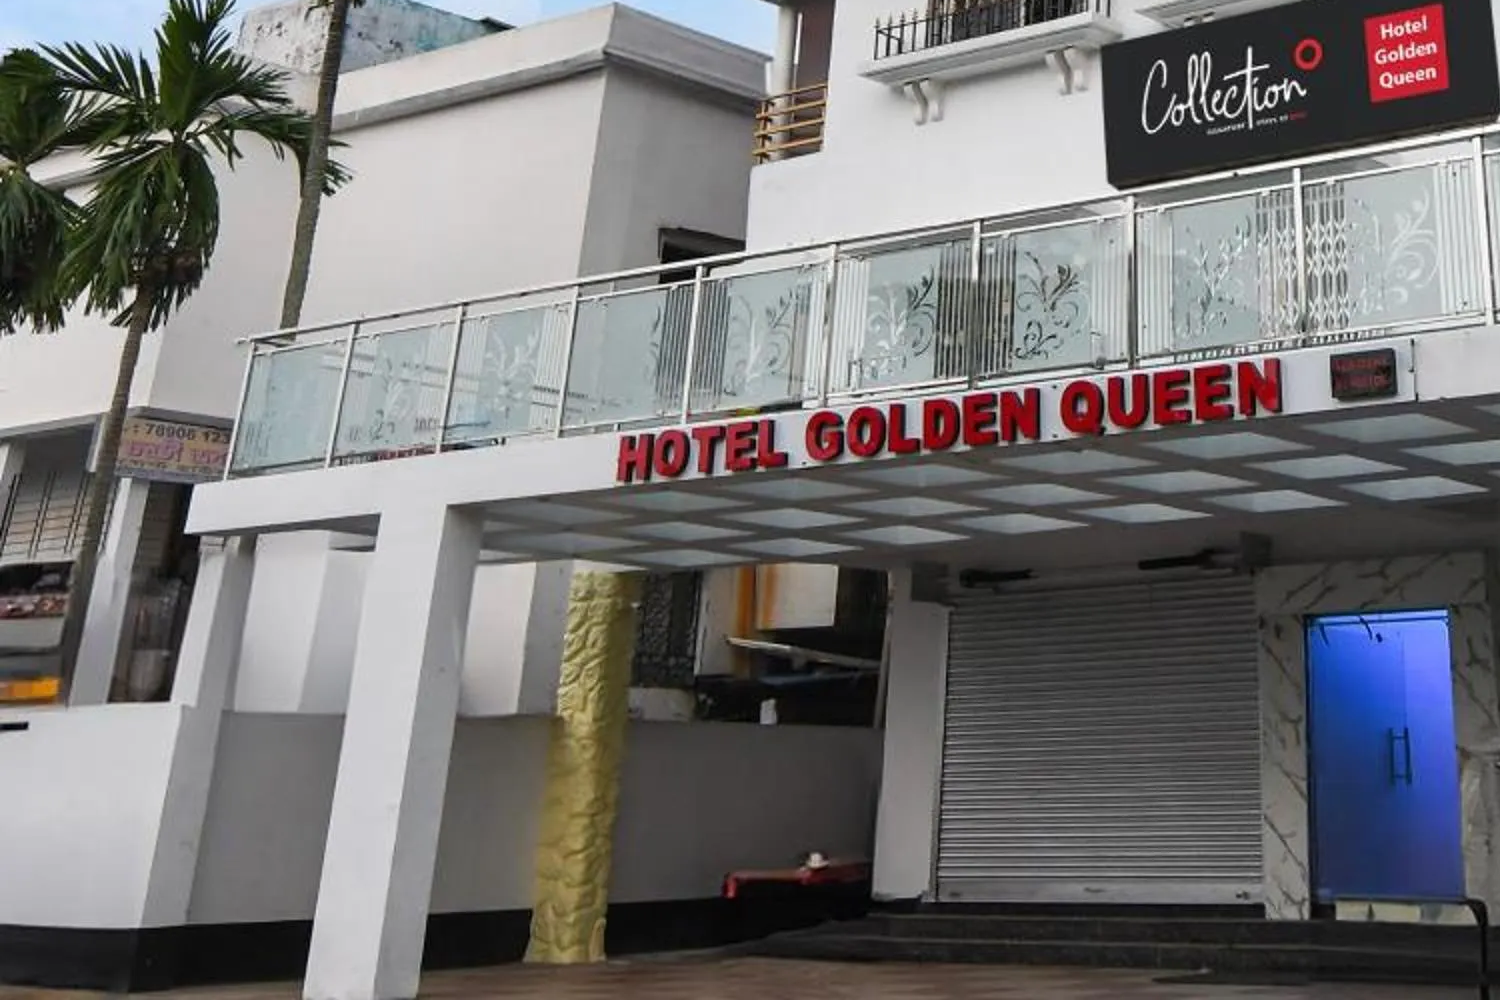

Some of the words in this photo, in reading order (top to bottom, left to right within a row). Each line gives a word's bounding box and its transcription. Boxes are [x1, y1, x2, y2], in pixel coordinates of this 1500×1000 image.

[1380, 14, 1427, 40] Hotel
[1374, 42, 1437, 65] Golden
[1141, 45, 1307, 135] Collection
[1379, 67, 1437, 89] Queen
[616, 419, 788, 484] HOTEL
[805, 386, 1042, 462] GOLDEN
[1059, 357, 1283, 438] QUEEN
